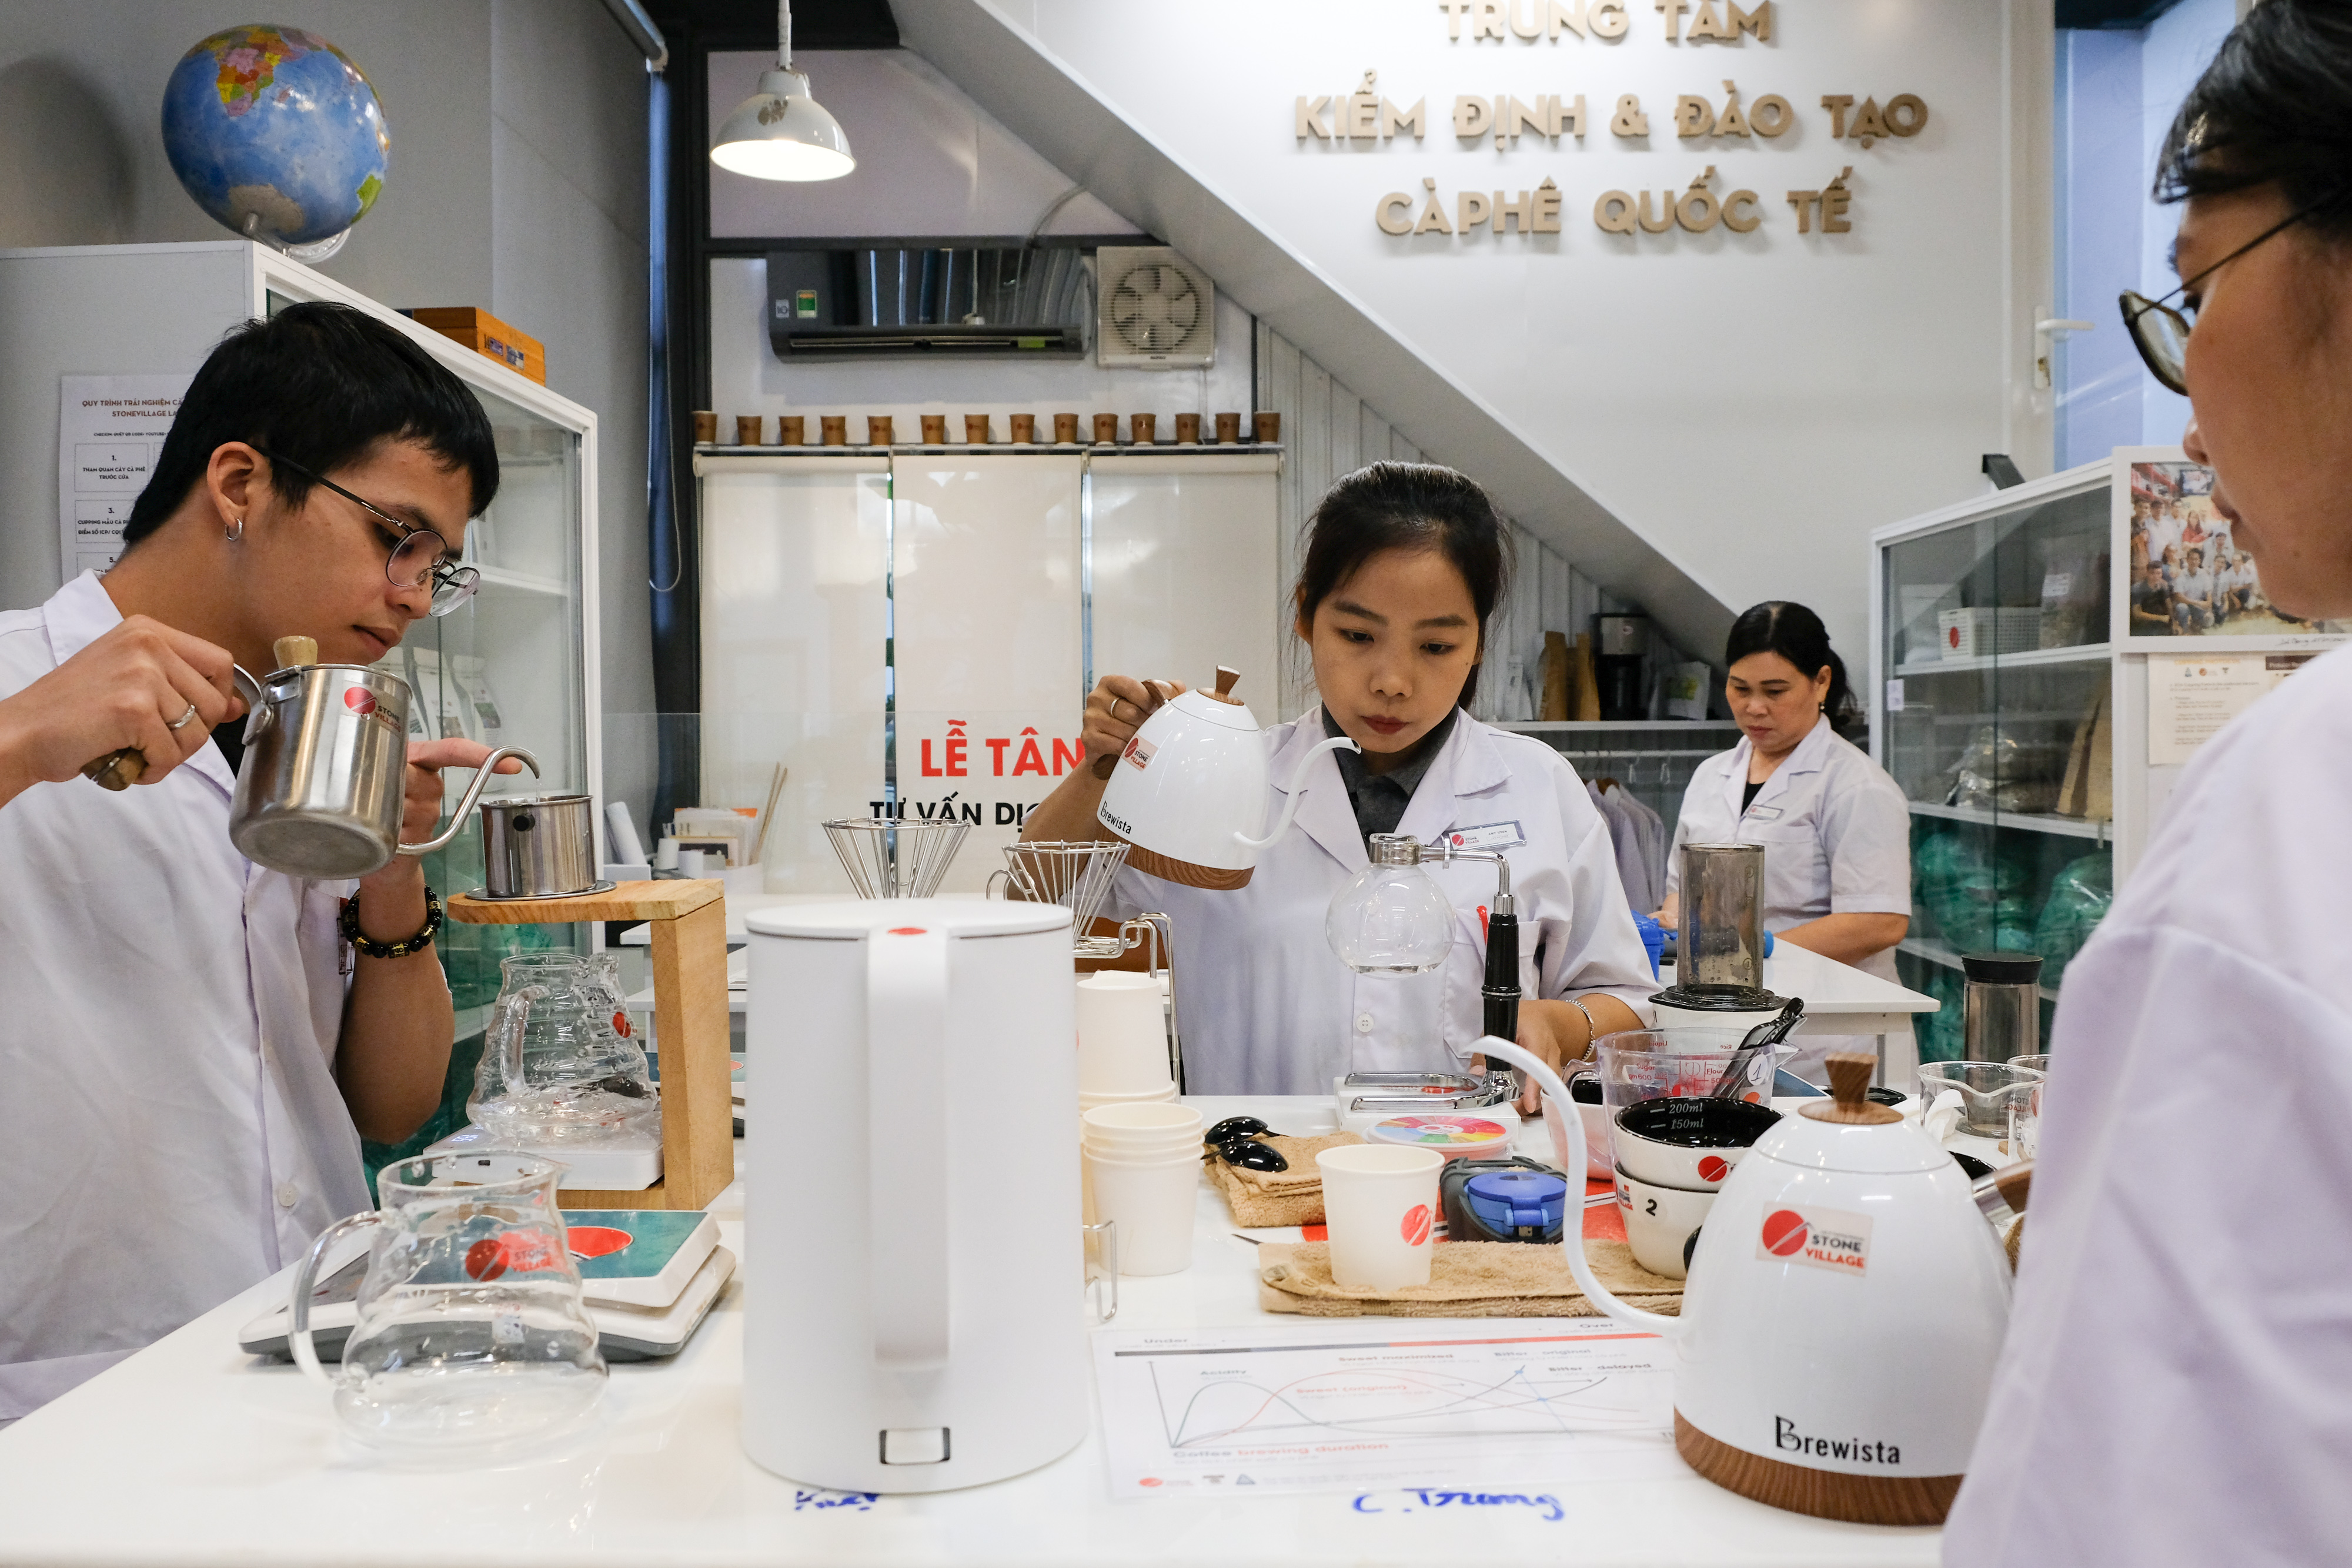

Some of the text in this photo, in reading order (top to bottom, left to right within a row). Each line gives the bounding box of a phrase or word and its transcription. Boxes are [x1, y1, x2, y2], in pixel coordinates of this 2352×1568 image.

[1439, 0, 1629, 41] TRUNG
[1296, 68, 1929, 152] KIỂM ĐỊNH & ĐÀO TẠO
[1593, 165, 1762, 235] QUỐC
[1786, 165, 1853, 233] TẾ
[142, 397, 171, 407] NGHIỆM
[377, 706, 400, 723] STONE
[921, 719, 1087, 777] LỄ TÂN
[1134, 750, 1148, 762] STONE
[1131, 756, 1147, 769] VILLAGE
[916, 791, 981, 825] VẤN
[1100, 800, 1132, 834] Brewista
[1636, 1063, 1655, 1071] Sugar
[1750, 1063, 1762, 1081] 1
[1669, 1103, 1703, 1114] 200ml
[1670, 1119, 1704, 1129] 150ml
[1646, 1199, 1658, 1216] 2
[1812, 1234, 1862, 1253] STONE
[1805, 1248, 1865, 1269] VILLAGE
[1775, 1415, 1900, 1464] Brewista
[1173, 1443, 1389, 1458] Coffee brewing duration
